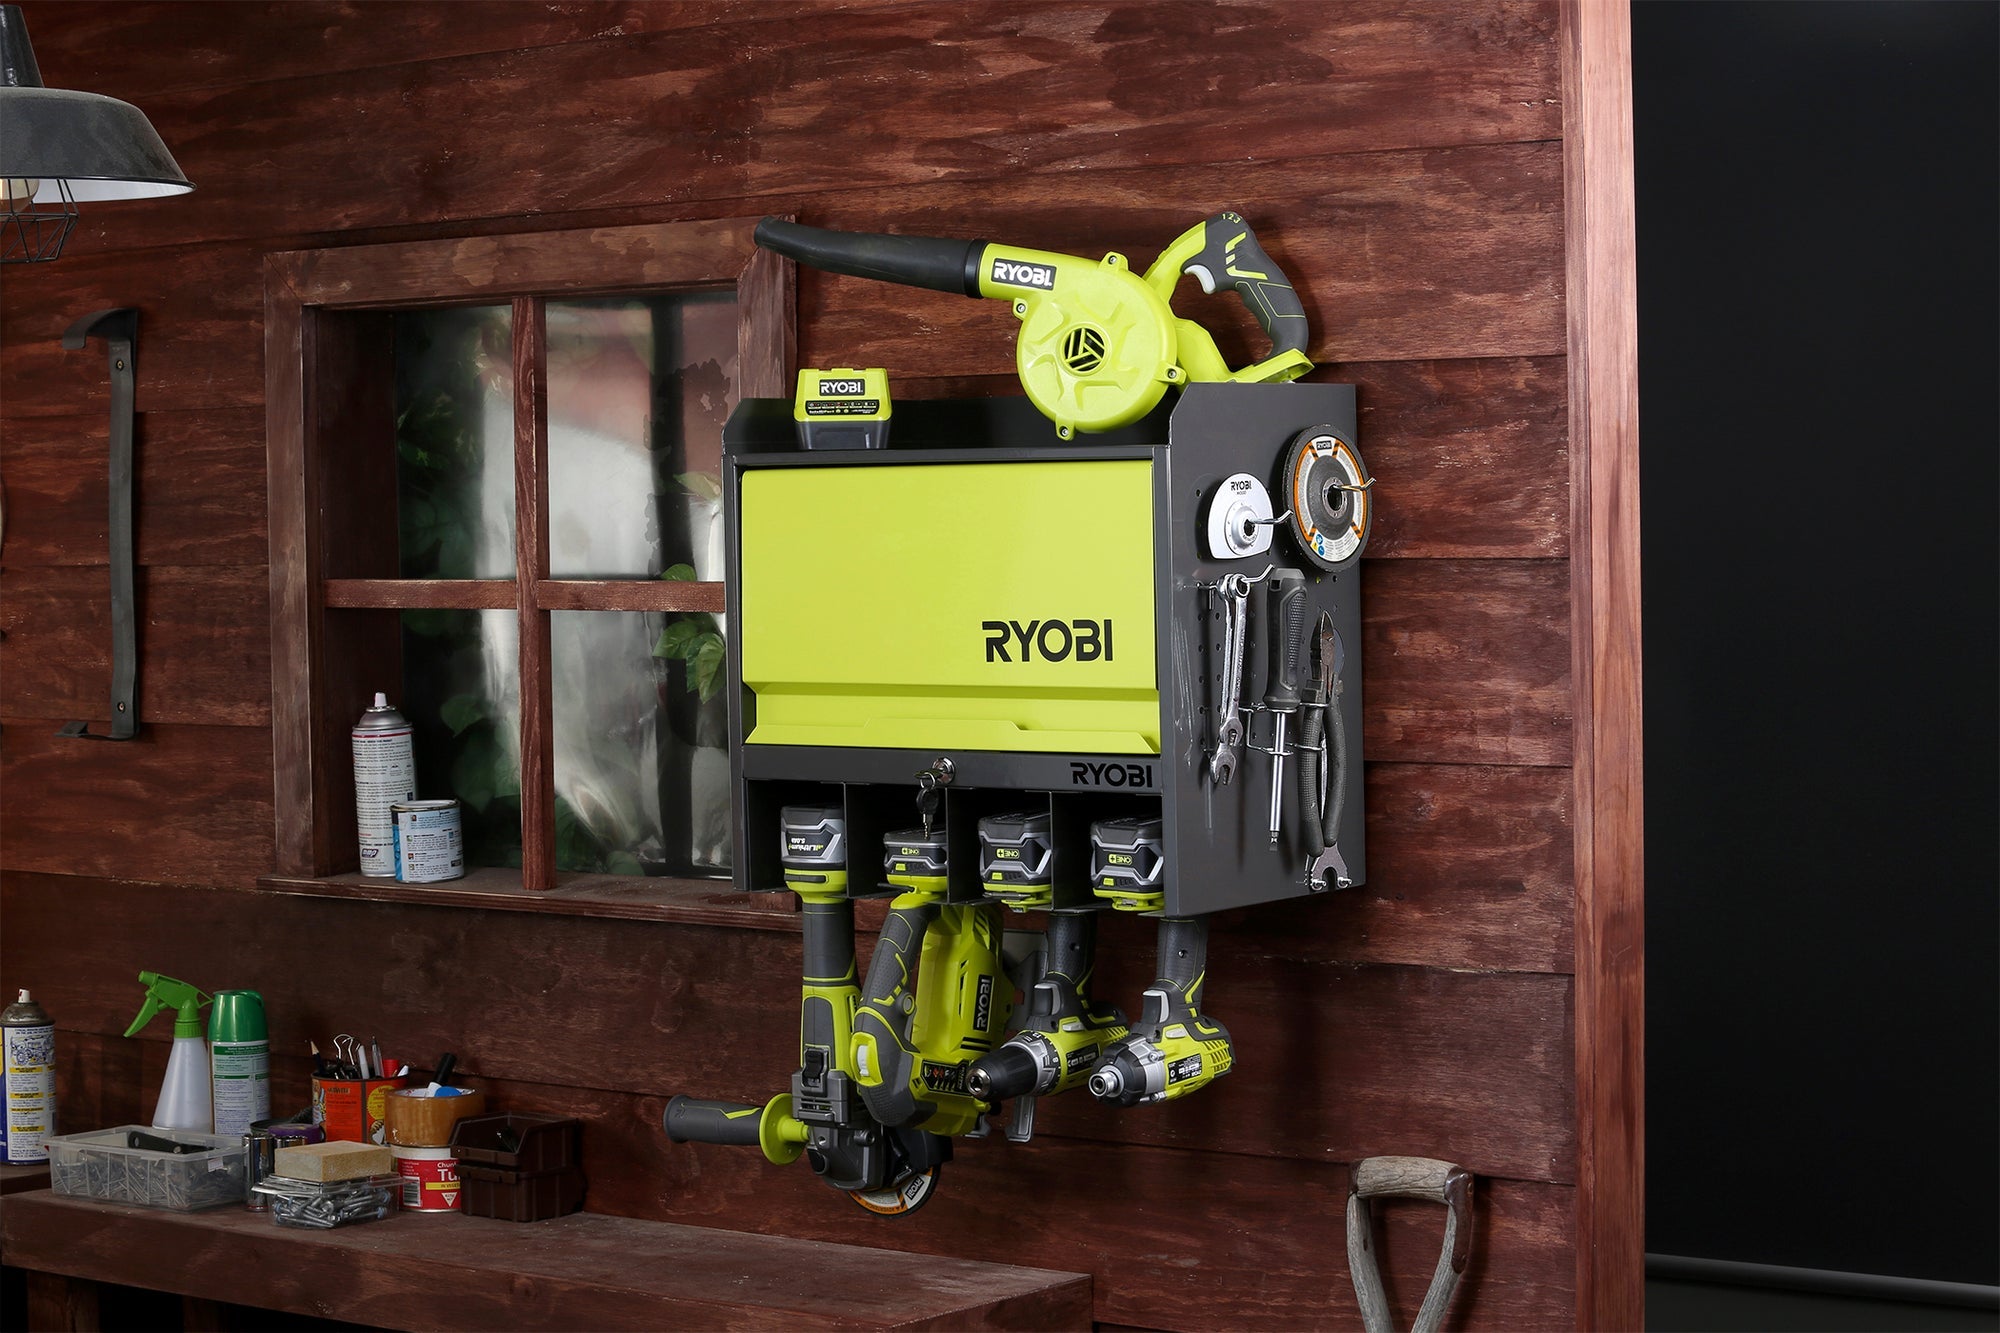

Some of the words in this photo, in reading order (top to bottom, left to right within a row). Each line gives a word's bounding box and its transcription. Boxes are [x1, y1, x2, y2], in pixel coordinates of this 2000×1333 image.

[1228, 213, 1235, 221] 2
[994, 261, 1053, 287] RYOBI
[820, 381, 862, 394] RYOBI
[1230, 480, 1252, 491] RYOBI
[982, 619, 1113, 662] RYOBI
[1070, 762, 1153, 788] RYOBI
[976, 978, 991, 1029] RYOBI
[437, 1168, 461, 1182] Tu
[906, 1177, 924, 1199] RYOBI
